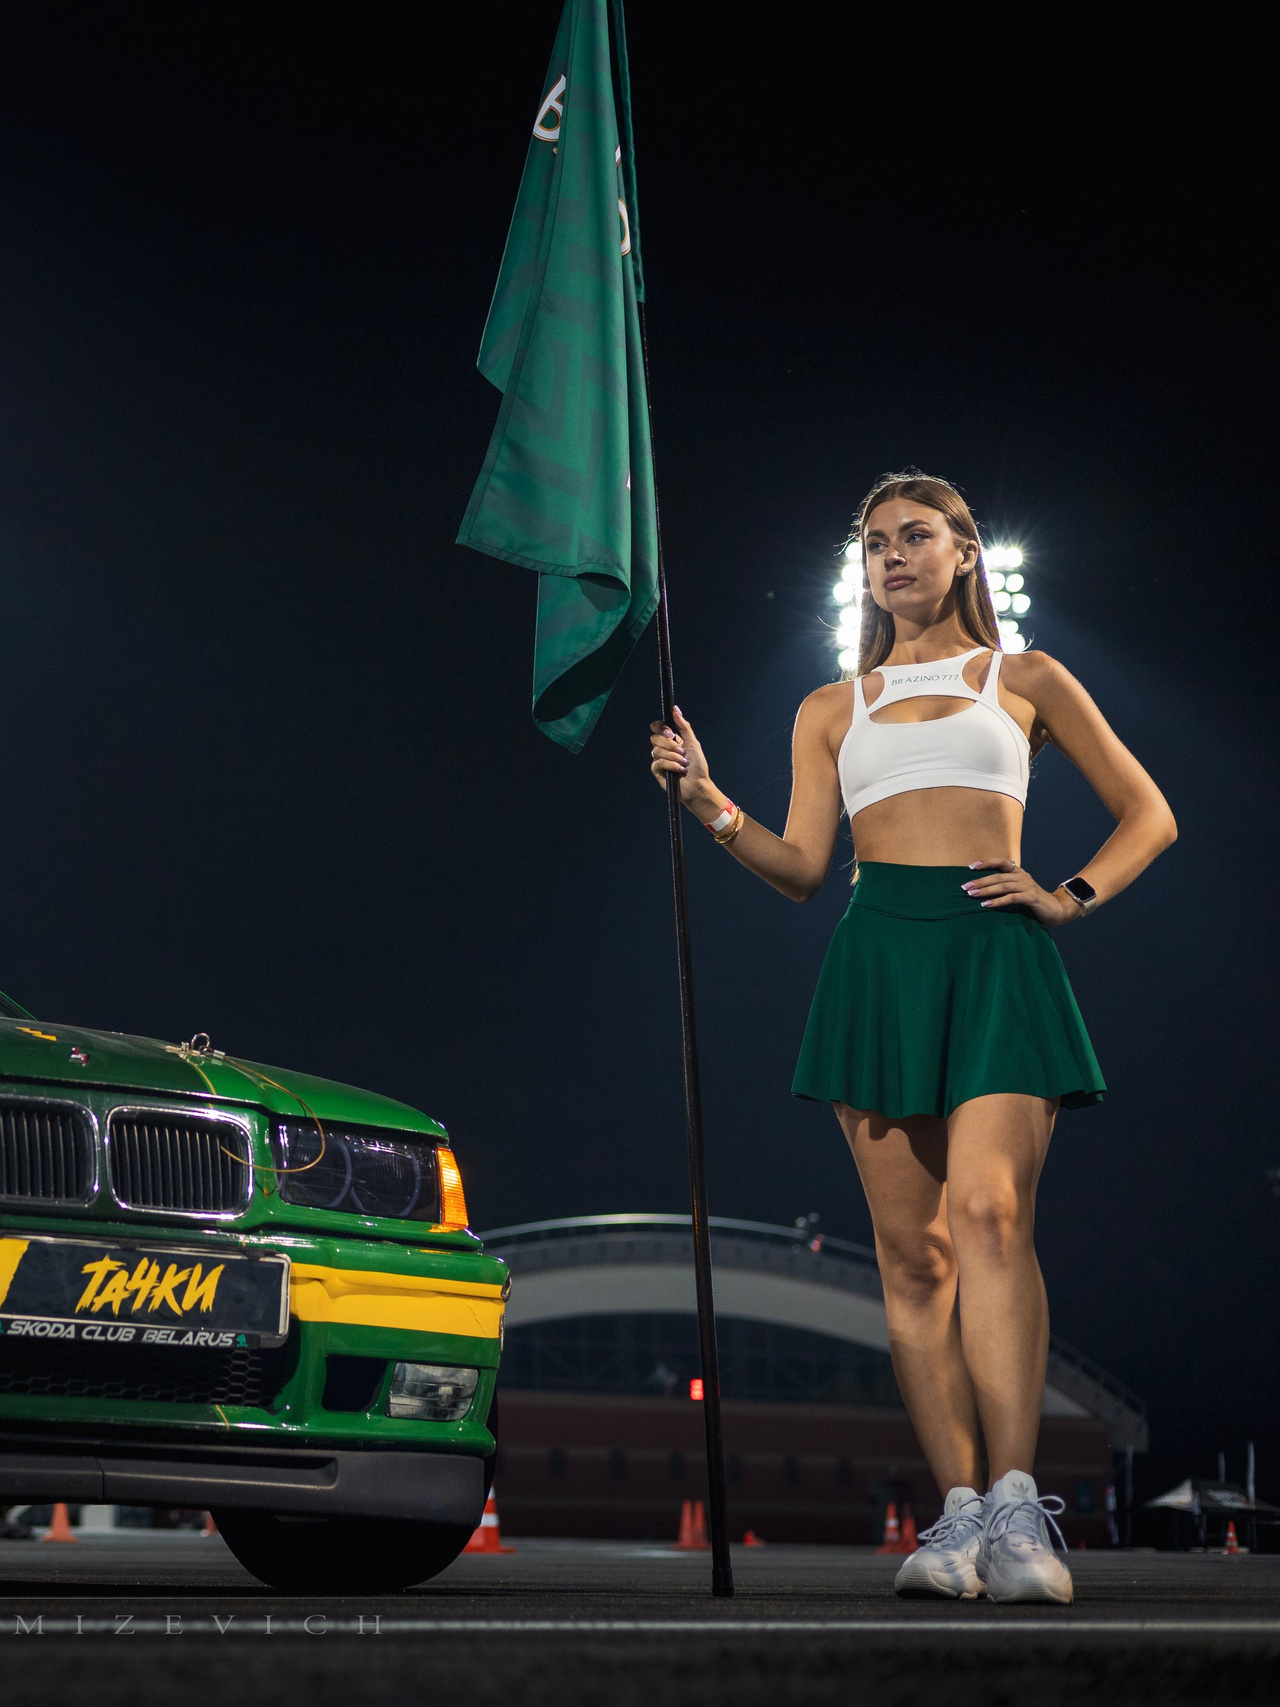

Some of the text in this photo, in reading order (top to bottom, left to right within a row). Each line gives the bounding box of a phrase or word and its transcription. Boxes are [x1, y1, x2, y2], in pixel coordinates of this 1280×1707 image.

[6, 1320, 236, 1348] SKODA CLUB BELARUS
